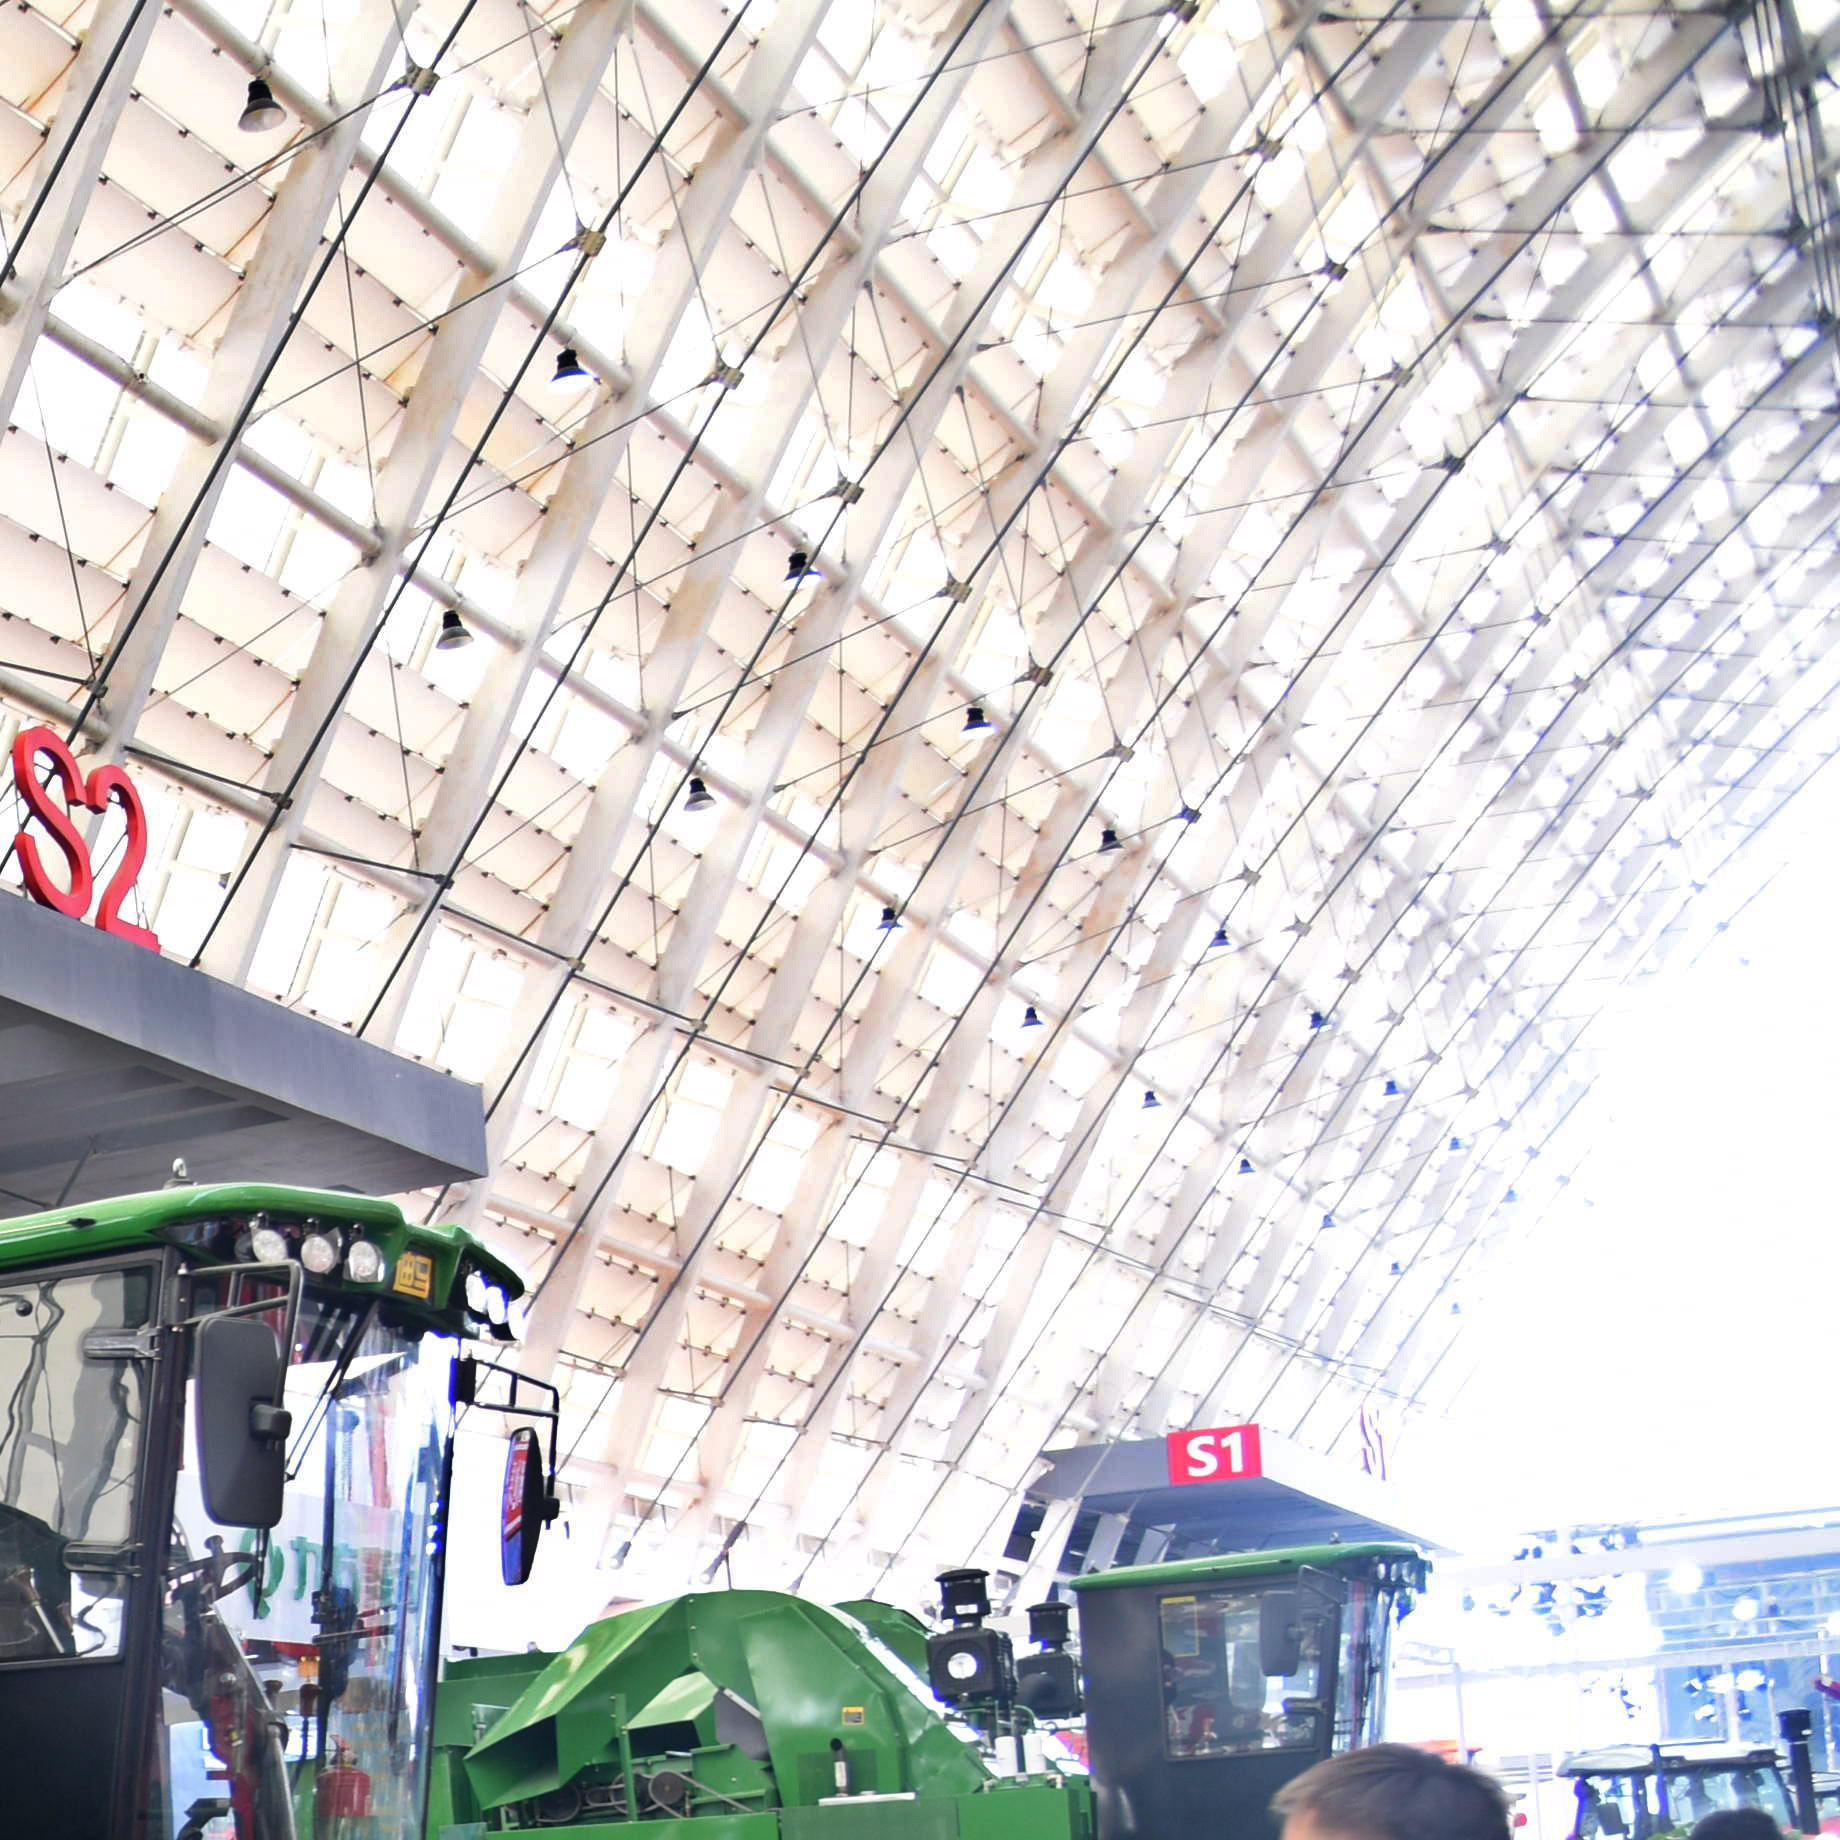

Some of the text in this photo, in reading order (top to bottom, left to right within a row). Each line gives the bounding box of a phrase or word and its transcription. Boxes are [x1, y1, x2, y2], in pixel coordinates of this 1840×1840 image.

[13, 725, 161, 953] S2
[393, 1251, 433, 1300] 迪马
[1186, 1432, 1244, 1478] S1
